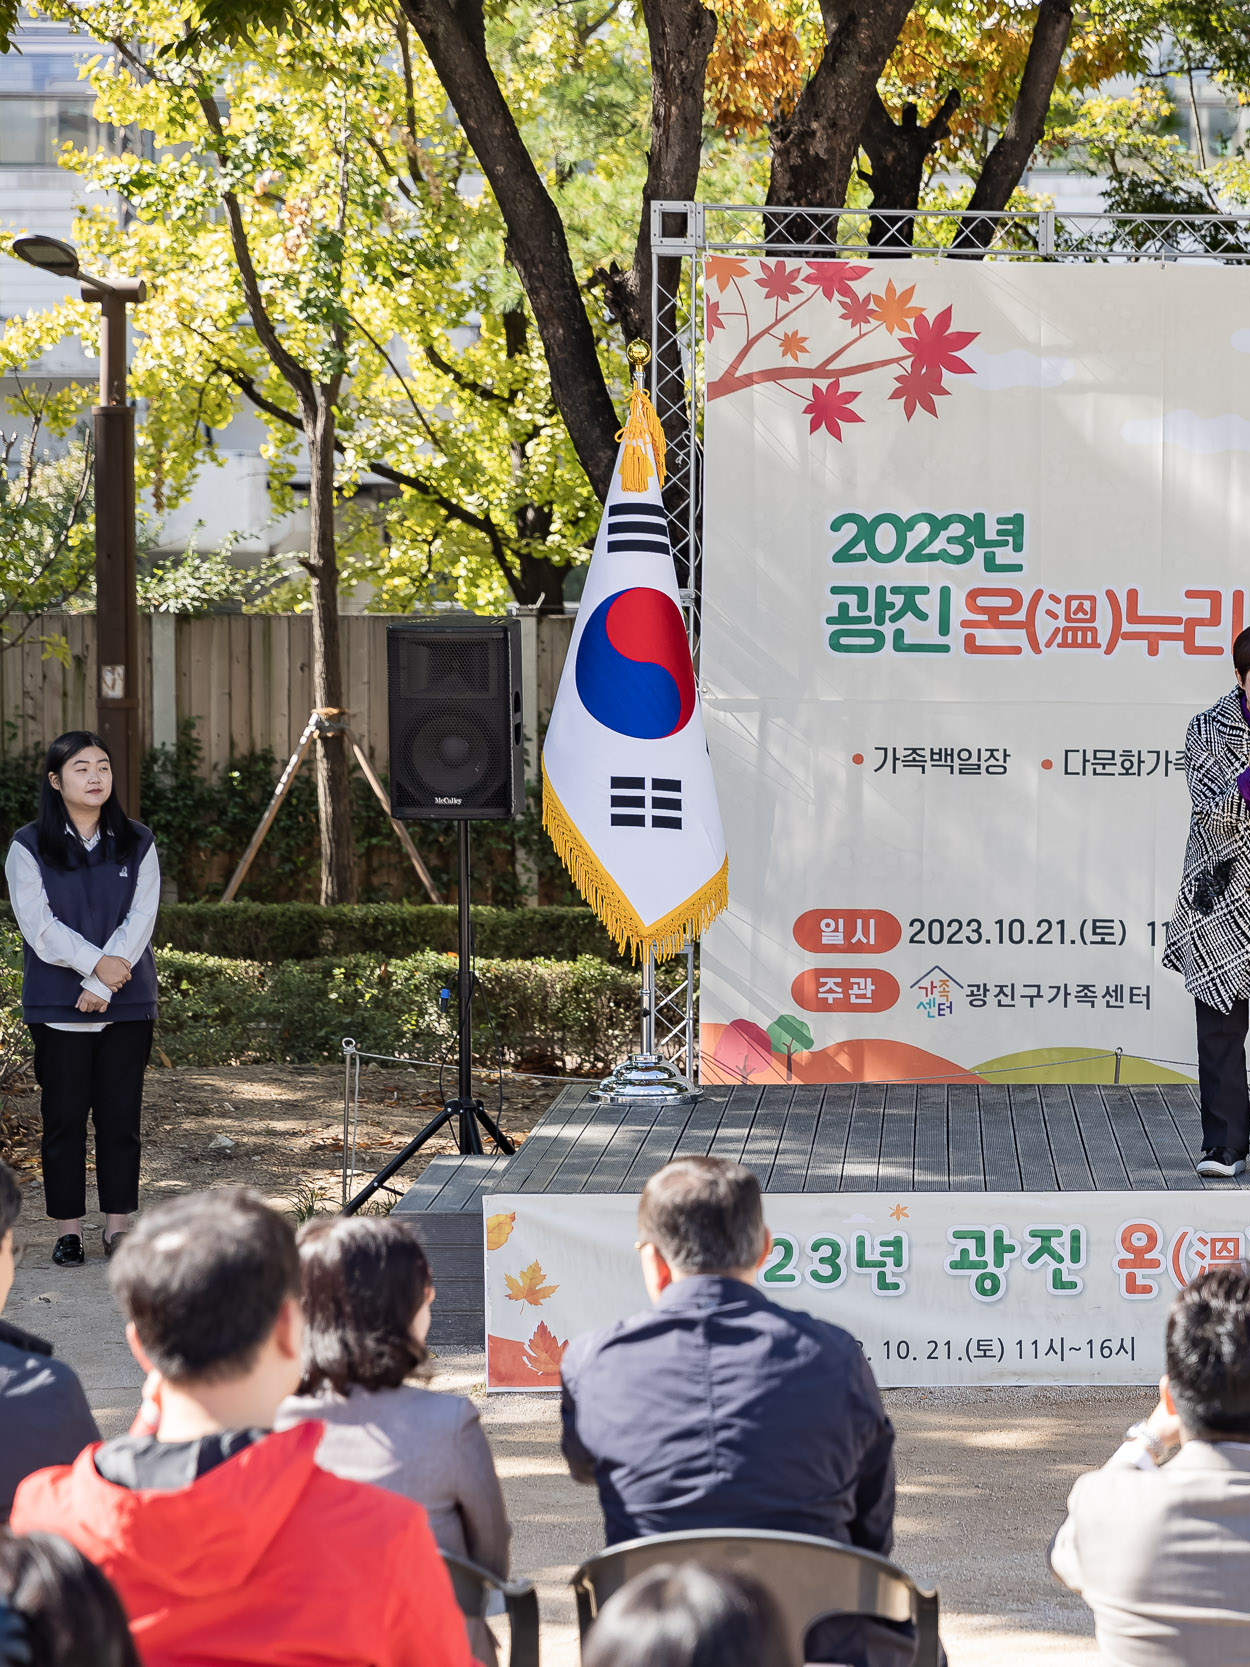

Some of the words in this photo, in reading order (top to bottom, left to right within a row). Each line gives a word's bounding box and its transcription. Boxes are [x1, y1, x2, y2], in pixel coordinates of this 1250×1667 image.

[830, 512, 1025, 573] 2023년
[825, 585, 951, 655] 광진
[873, 746, 1011, 776] 가족백일장
[819, 918, 876, 945] 일시
[908, 917, 1127, 946] 2023.10.21.(토)
[817, 977, 876, 1004] 주관
[918, 979, 951, 1003] 가족
[965, 982, 1151, 1011] 광진구가족센터
[916, 997, 953, 1018] 센터
[950, 1229, 1081, 1297] 광진
[1015, 1336, 1135, 1362] 11시~16시
